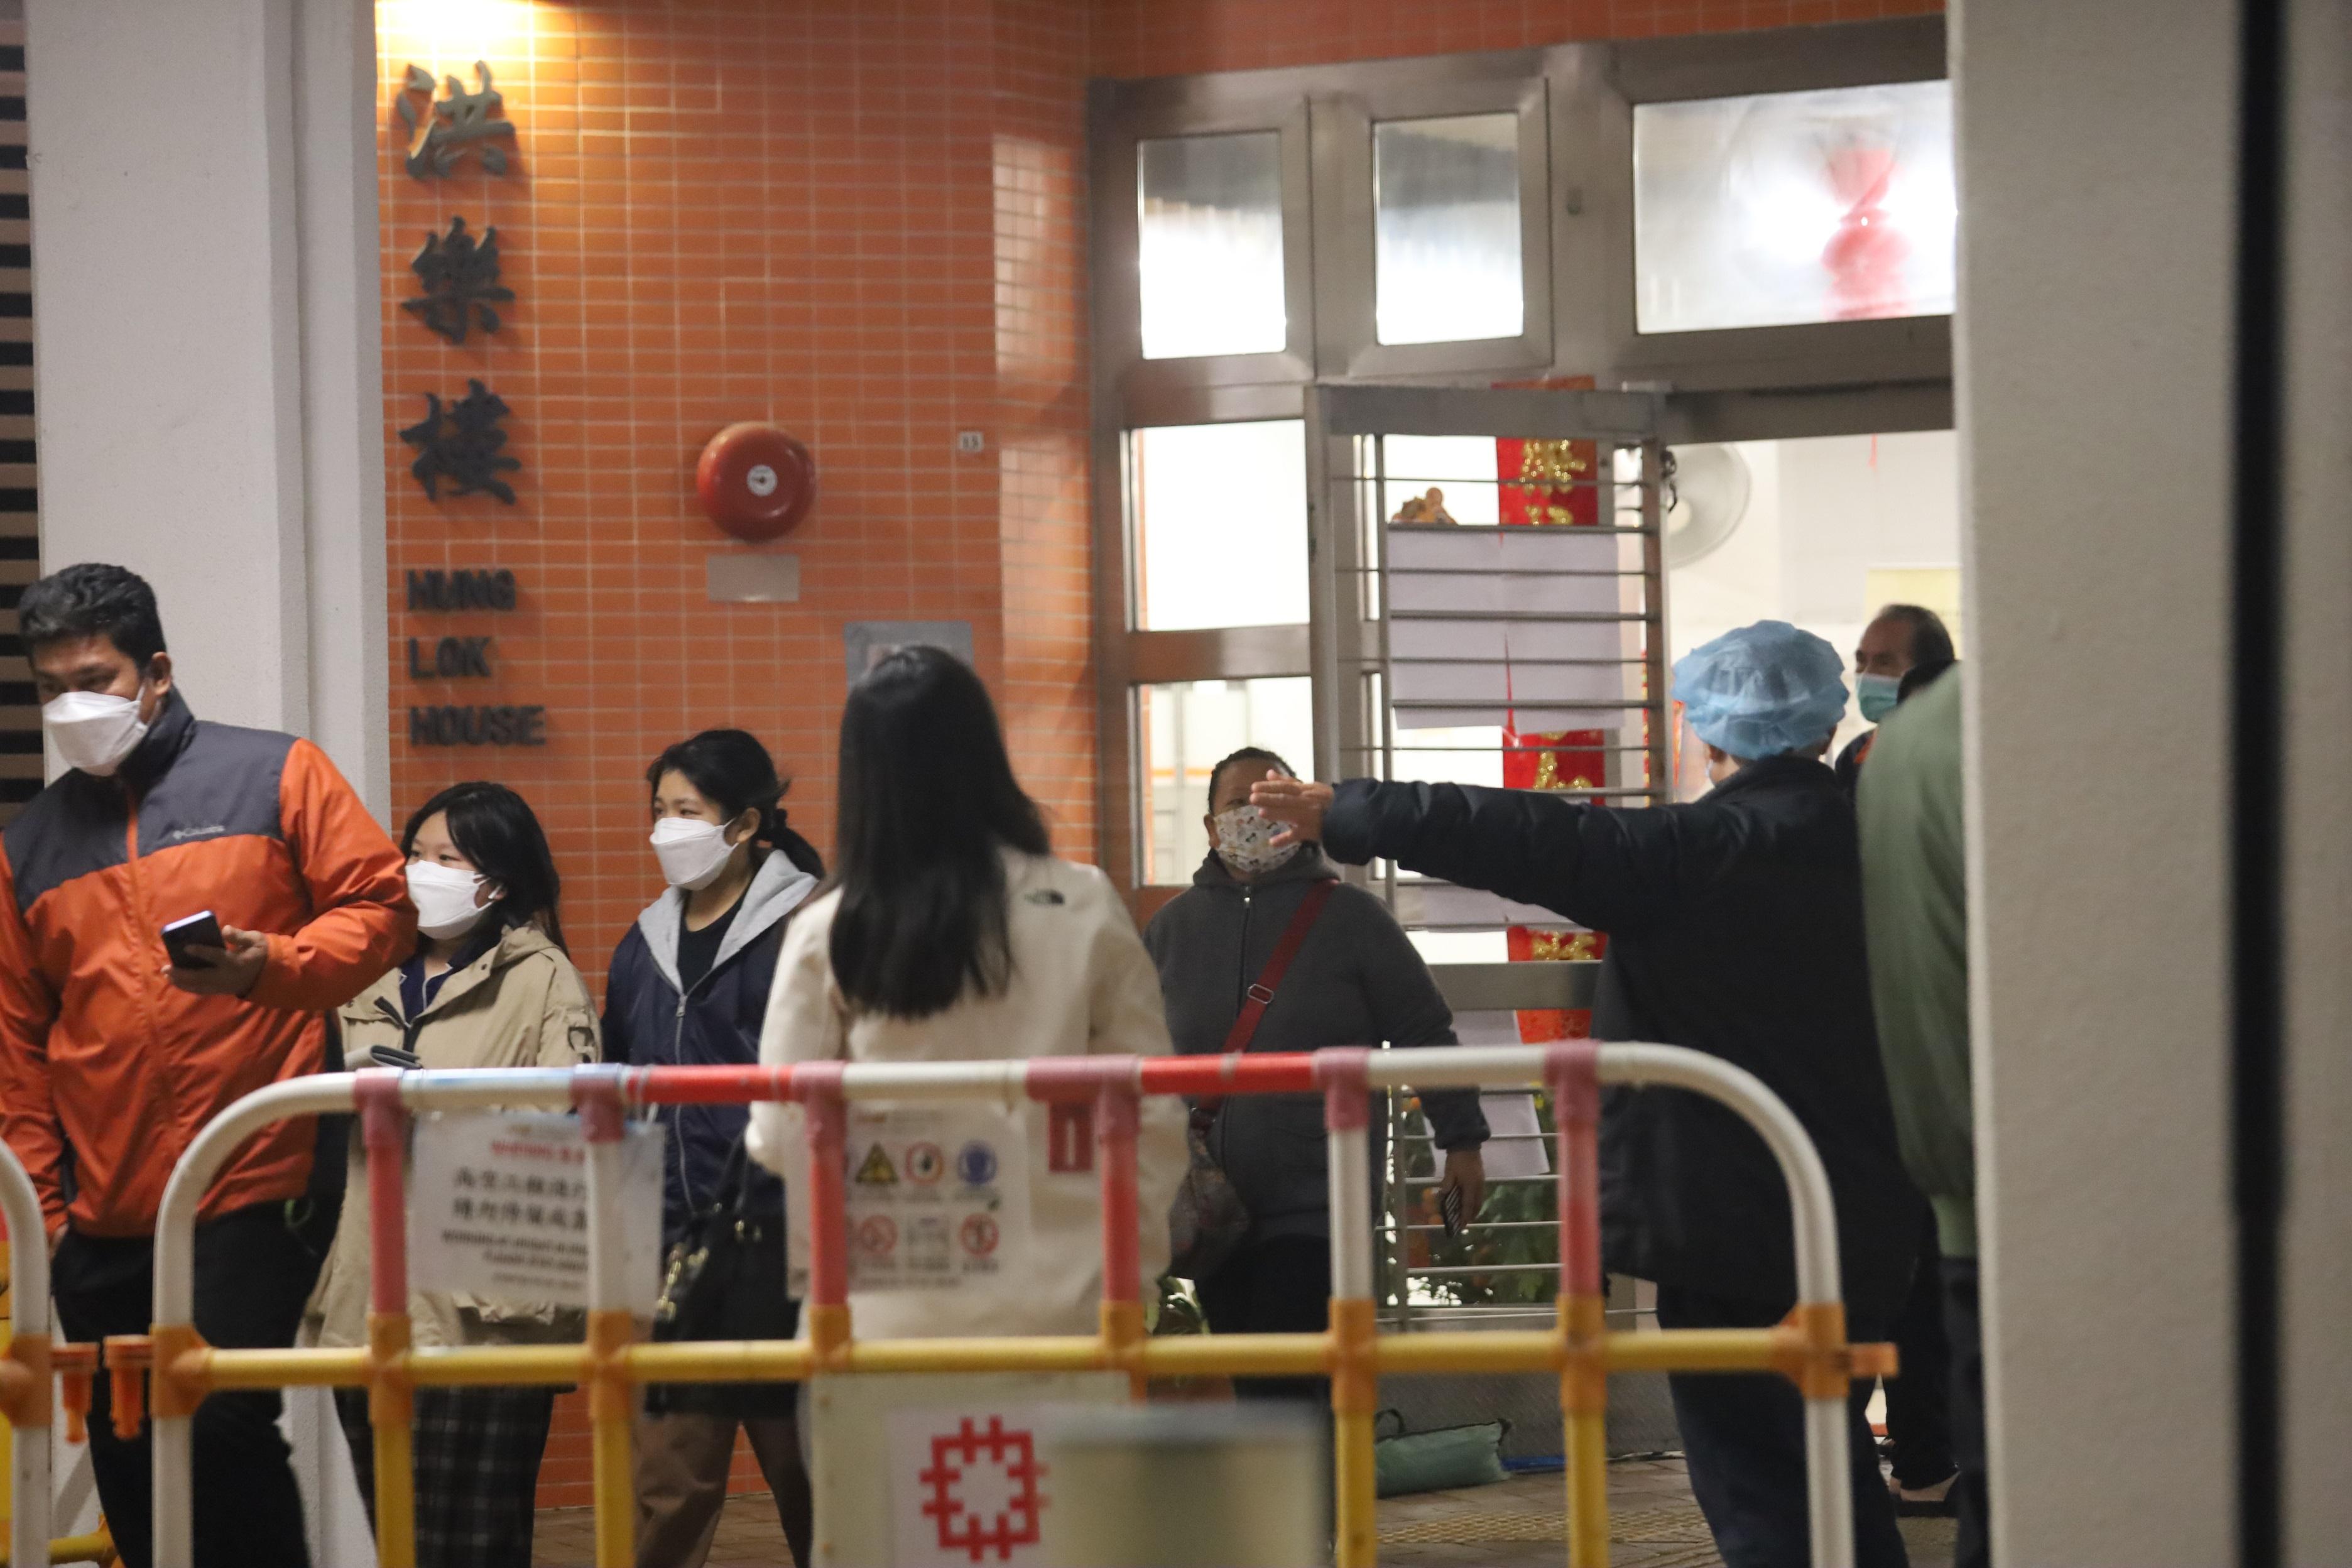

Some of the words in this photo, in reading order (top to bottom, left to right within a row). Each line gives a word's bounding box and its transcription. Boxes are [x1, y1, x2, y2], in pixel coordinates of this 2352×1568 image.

[396, 60, 521, 504] 洪樂樓
[407, 569, 515, 610] HUNG
[409, 636, 491, 678] LOK
[411, 705, 545, 746] HOUSE
